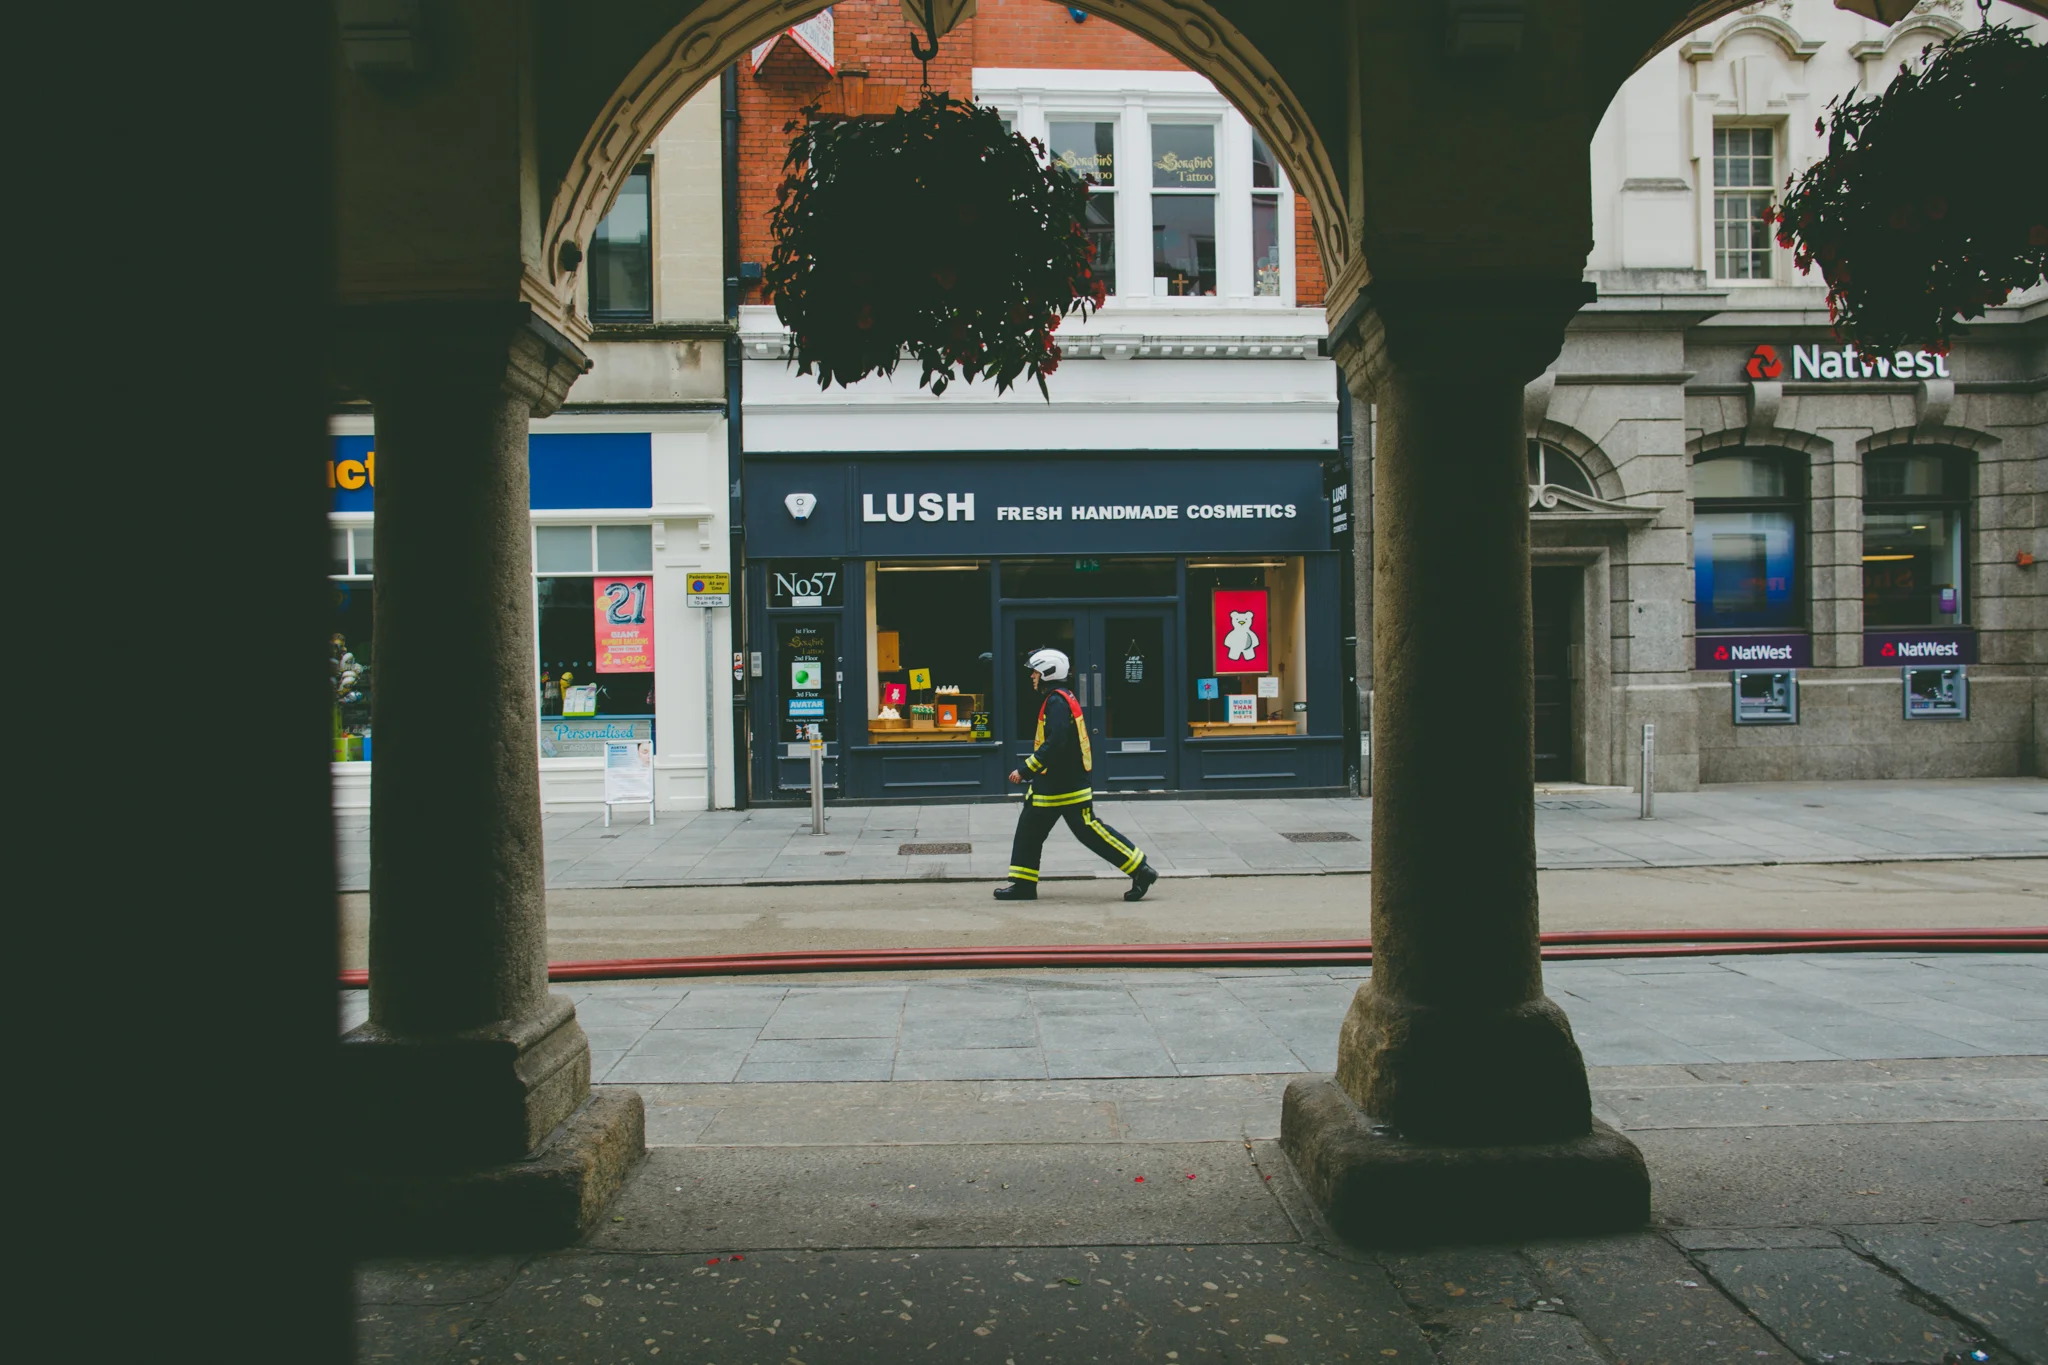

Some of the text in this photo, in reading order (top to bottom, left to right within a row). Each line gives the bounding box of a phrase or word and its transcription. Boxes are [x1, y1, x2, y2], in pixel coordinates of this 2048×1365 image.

[1154, 152, 1213, 173] Songbird
[1176, 170, 1213, 182] Tattoo
[1332, 484, 1347, 504] LUSH
[863, 493, 975, 522] LUSH
[997, 504, 1297, 521] FRESH HANDMADE COSMETICS
[604, 582, 646, 624] 21
[611, 631, 640, 639] GIANT
[1731, 645, 1792, 660] NatWest
[1898, 642, 1958, 656] NatWest
[603, 652, 613, 665] 2
[790, 701, 823, 709] AVATAR
[974, 714, 989, 725] 25
[553, 724, 636, 740] Personalised
[562, 744, 593, 752] CARDS
